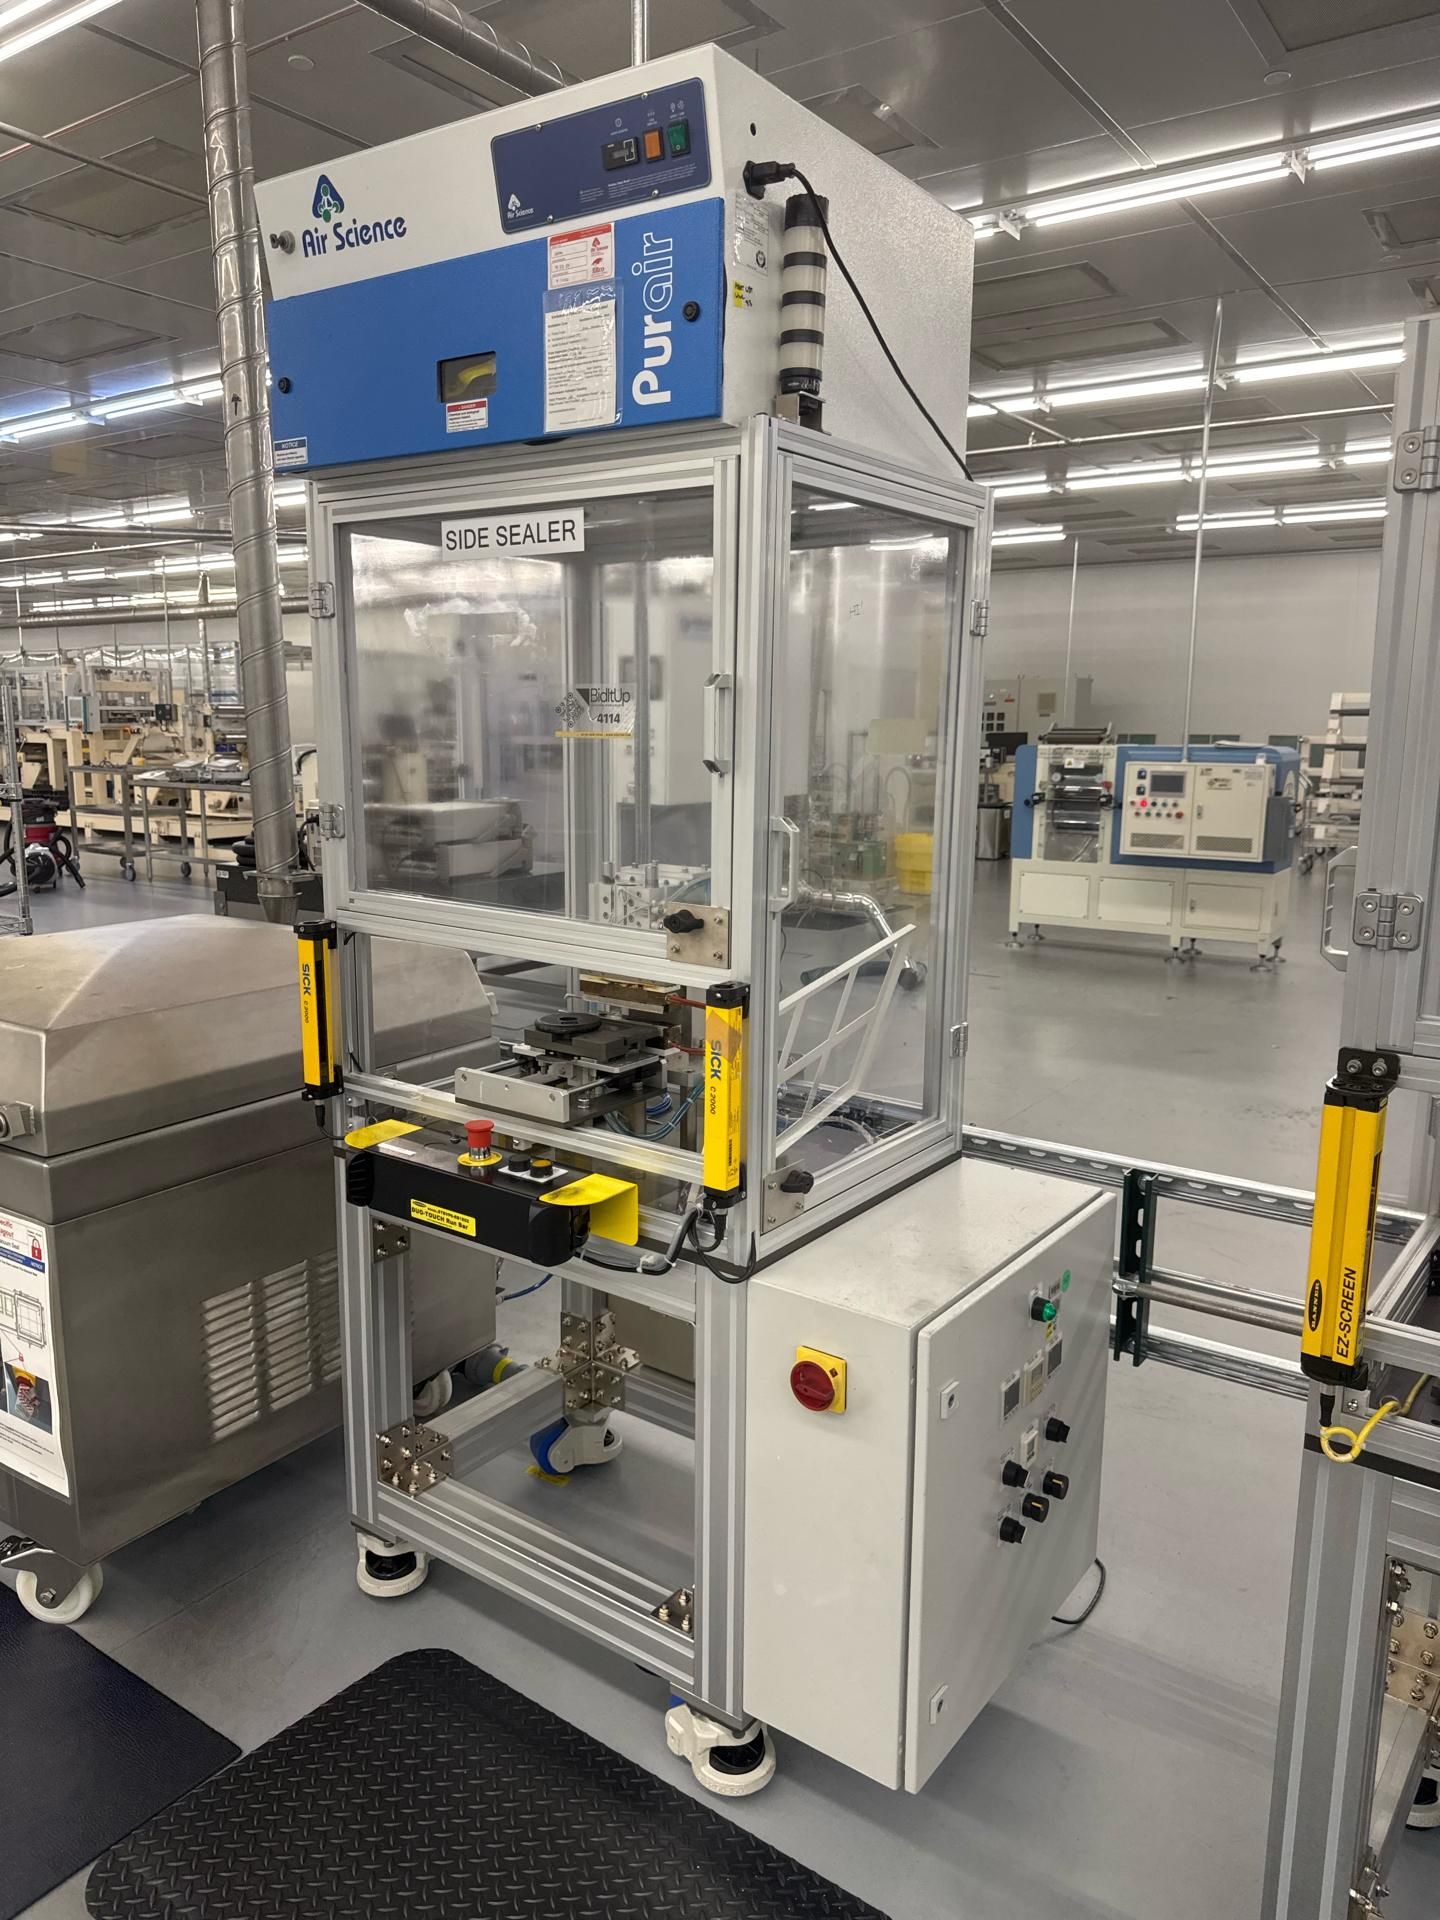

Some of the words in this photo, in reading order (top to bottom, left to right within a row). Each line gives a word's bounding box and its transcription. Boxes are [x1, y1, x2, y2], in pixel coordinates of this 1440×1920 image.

[302, 227, 328, 258] Air
[333, 216, 407, 251] Science
[631, 231, 673, 406] Purair
[281, 441, 299, 449] NOTICE
[446, 527, 489, 551] SIDE
[496, 519, 576, 547] SEALER
[590, 688, 631, 707] BidItUp
[596, 713, 621, 724] 4114
[302, 963, 311, 996] SICK
[711, 1040, 722, 1081] SICK
[411, 1207, 445, 1223] DUO-TOUCH
[446, 1218, 457, 1226] Run
[458, 1222, 469, 1230] Bar
[1311, 1281, 1320, 1329] BANNER
[1336, 1266, 1357, 1359] EZ-SCREEN
